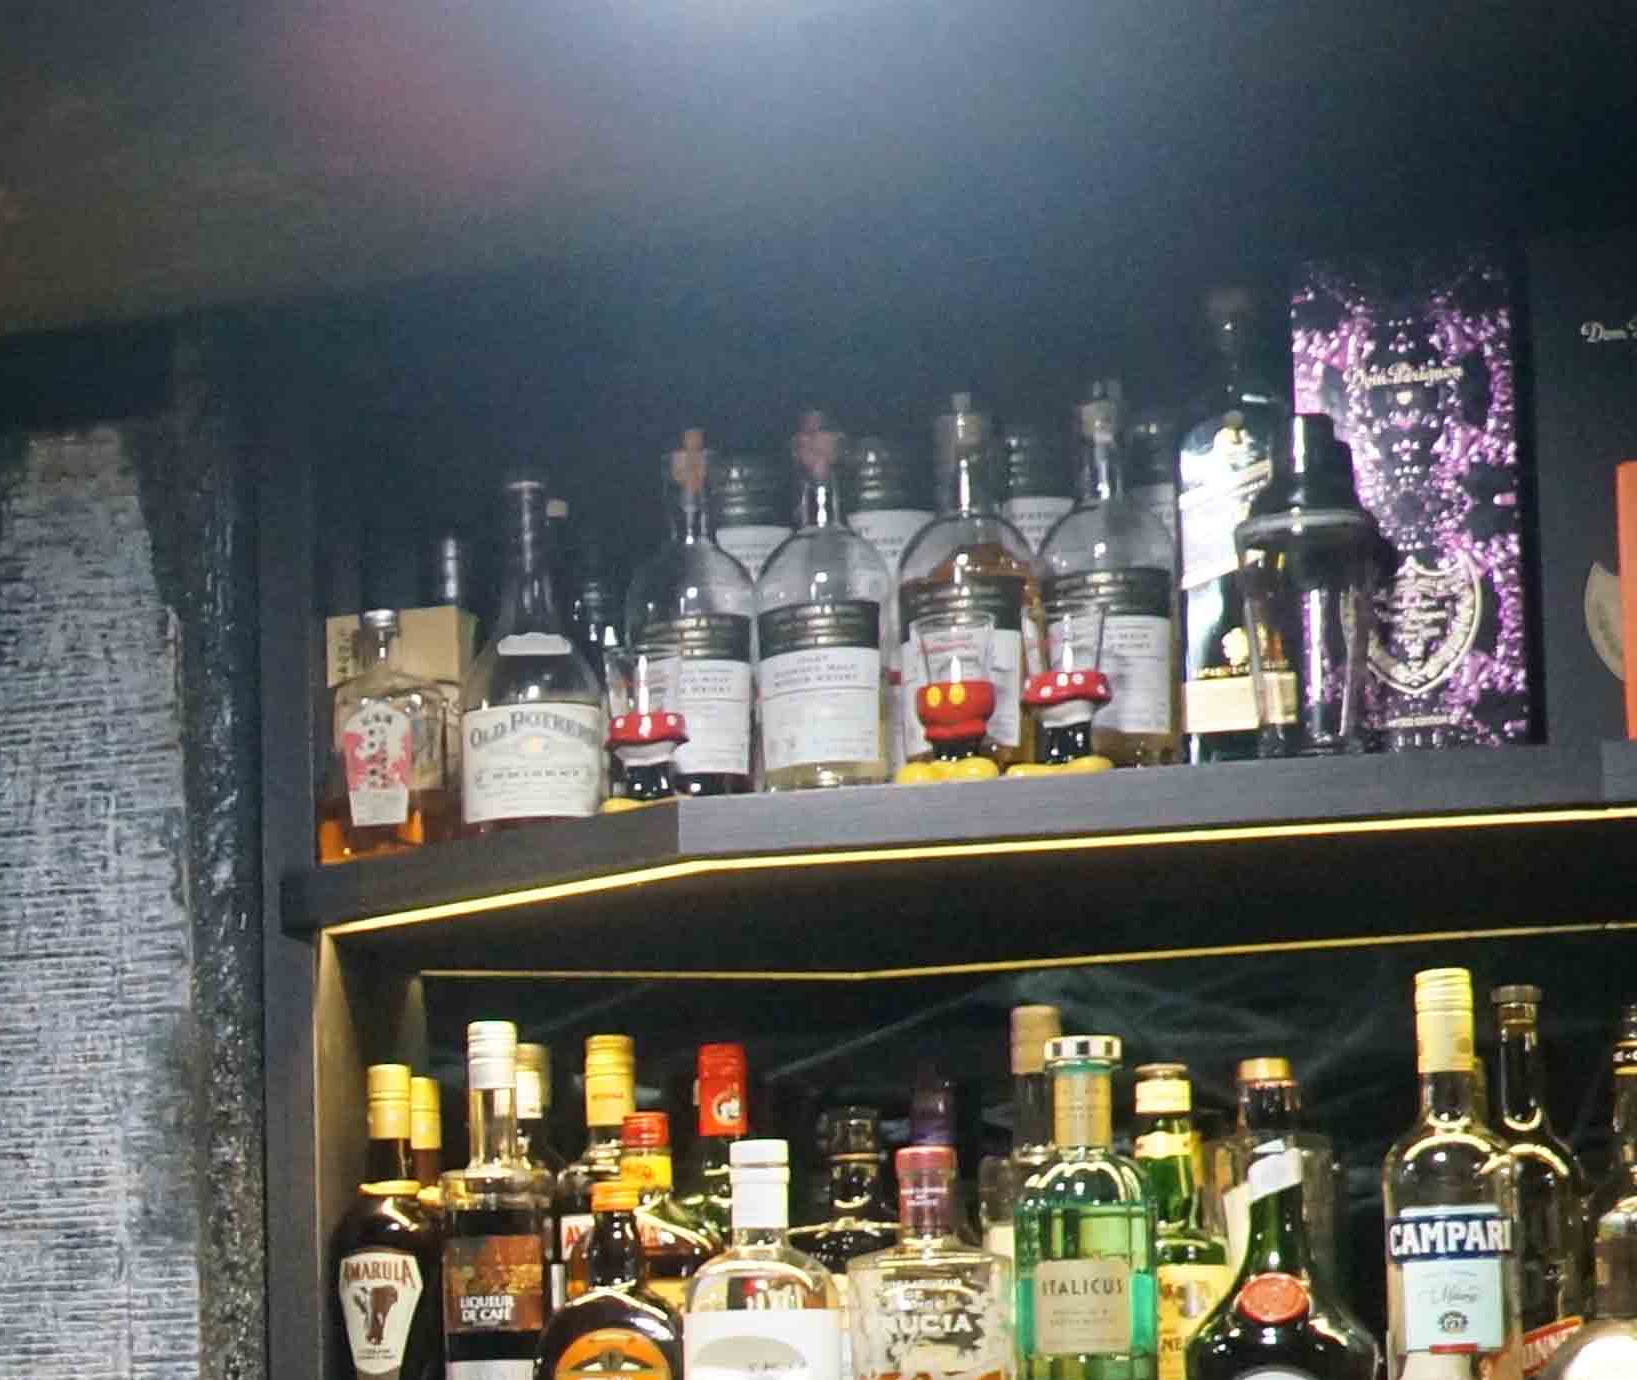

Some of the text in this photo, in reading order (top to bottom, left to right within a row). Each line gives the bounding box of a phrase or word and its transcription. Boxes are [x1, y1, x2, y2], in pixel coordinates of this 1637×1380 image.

[469, 721, 507, 749] OLD
[1389, 1219, 1513, 1257] CAMPARI
[343, 1259, 415, 1289] AMARULA
[1042, 1278, 1123, 1297] ITALICUS
[459, 1295, 516, 1310] LIQUEUR
[461, 1310, 478, 1322] DE
